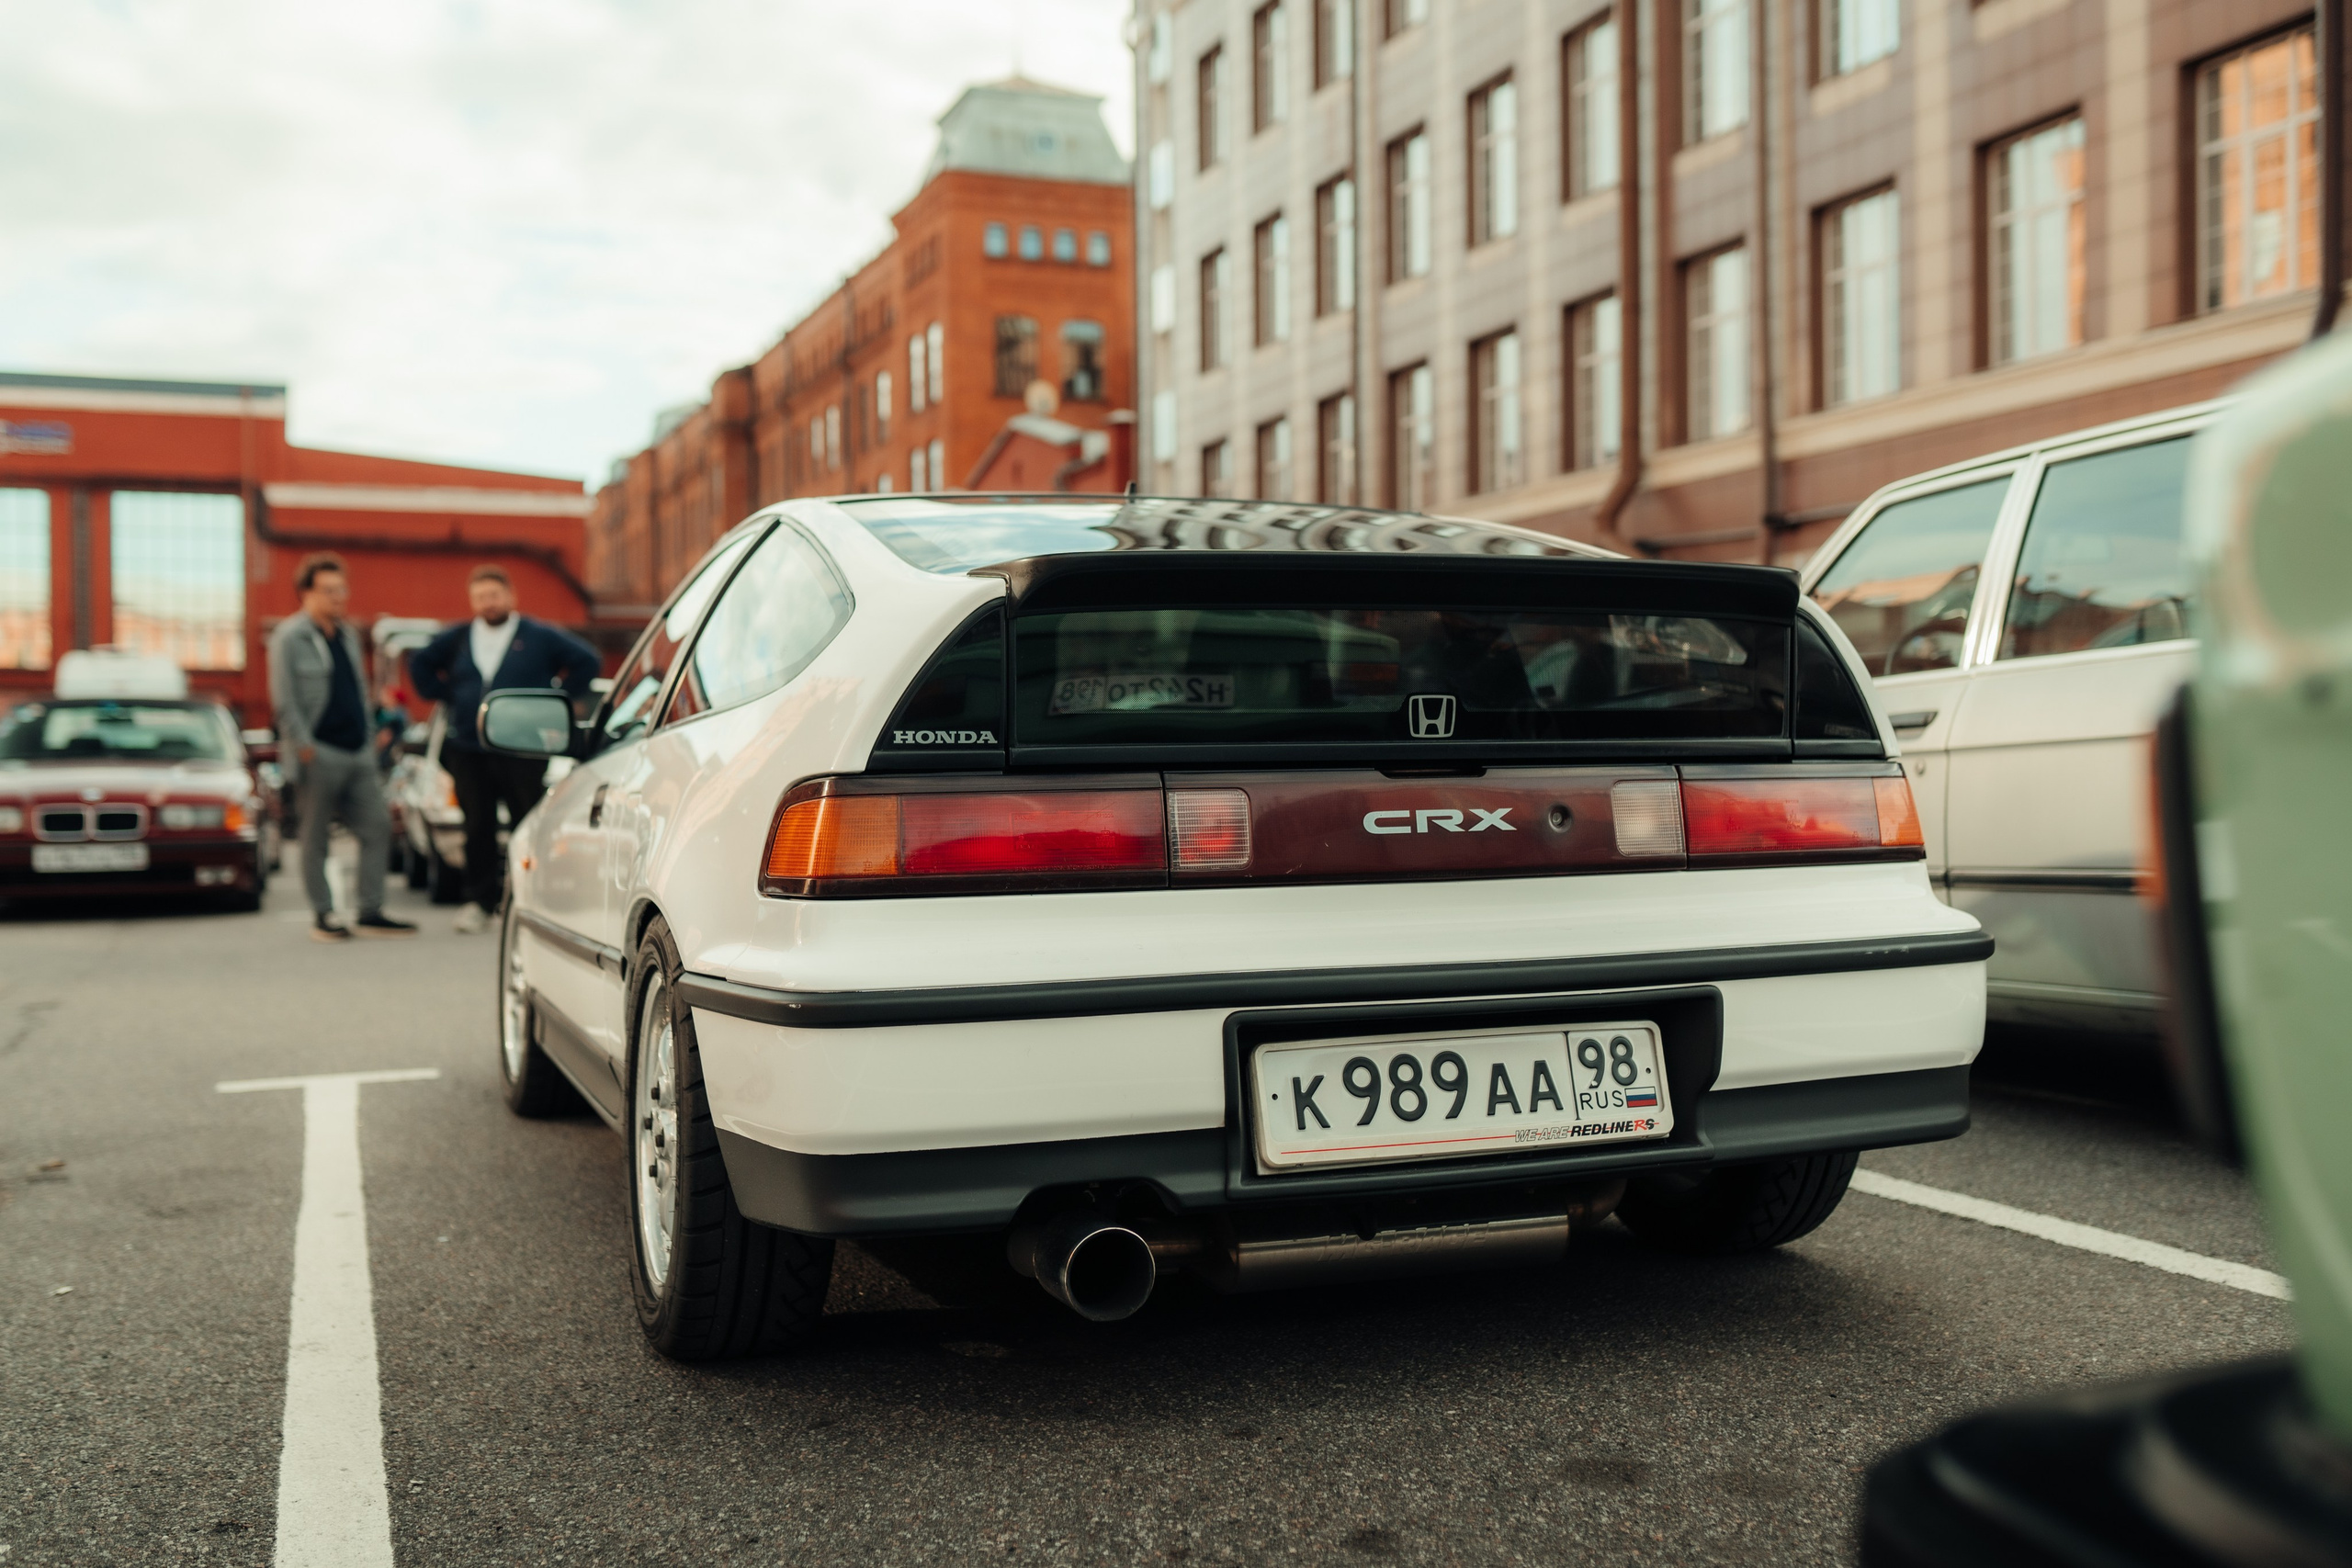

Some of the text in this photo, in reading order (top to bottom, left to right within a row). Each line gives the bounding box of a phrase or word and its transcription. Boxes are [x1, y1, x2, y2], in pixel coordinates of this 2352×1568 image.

[893, 730, 998, 744] HONDA
[1363, 807, 1518, 835] CRX
[1577, 1035, 1638, 1089] 98
[1579, 1091, 1624, 1111] RUS
[1514, 1118, 1656, 1143] WE ARE REDLINERS
